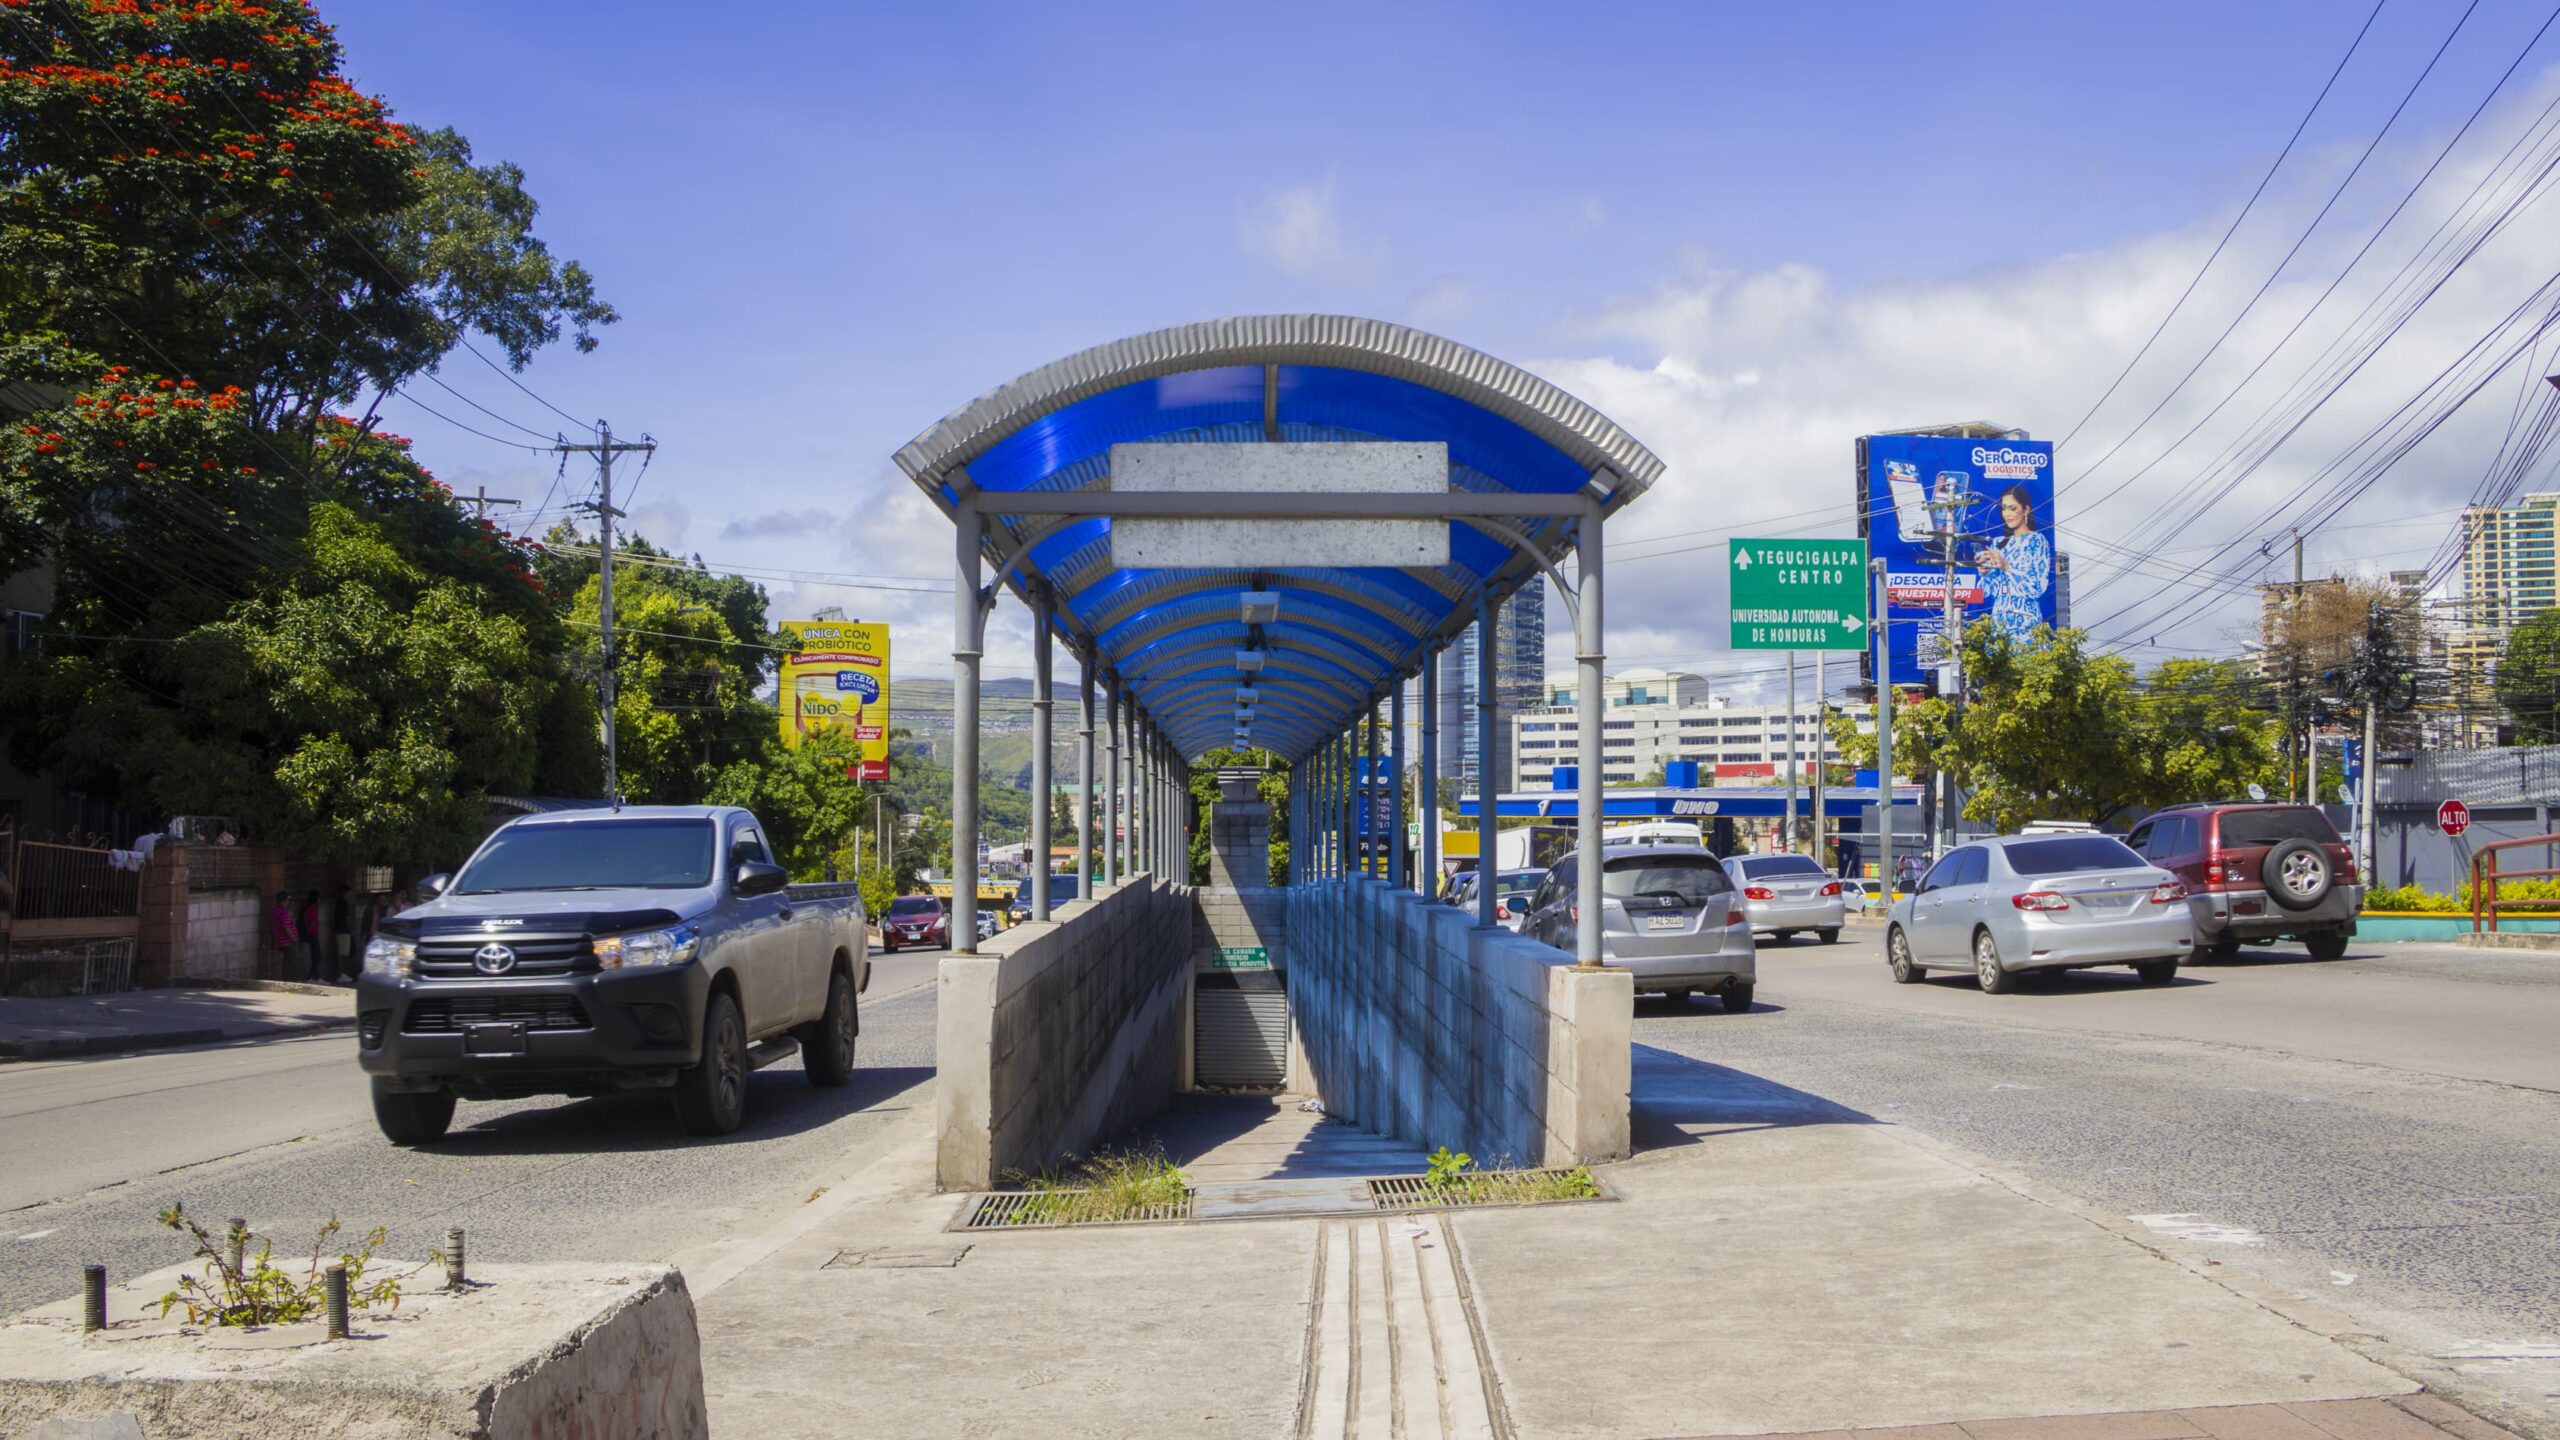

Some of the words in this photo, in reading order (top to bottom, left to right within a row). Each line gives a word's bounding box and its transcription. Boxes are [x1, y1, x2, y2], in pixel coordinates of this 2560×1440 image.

[1987, 465, 2033, 474] LOGISTICS
[1757, 550, 1858, 566] TEGUCIGALPA
[1778, 569, 1843, 585] CENTRO
[1889, 575, 1962, 587] ¡DESCARA
[1897, 588, 1945, 599] NUESTRA
[1732, 608, 1789, 624] UNIVERSIDAD
[1791, 608, 1840, 624] AUTONOMA
[802, 627, 841, 640] ÚNICA
[843, 629, 871, 640] CON
[1752, 628, 1766, 643] DE
[1770, 628, 1826, 643] HONDURAS
[840, 673, 876, 687] RECETA
[803, 703, 839, 715] NIDO
[1672, 800, 1719, 814] UNO
[2441, 811, 2467, 825] ALTO
